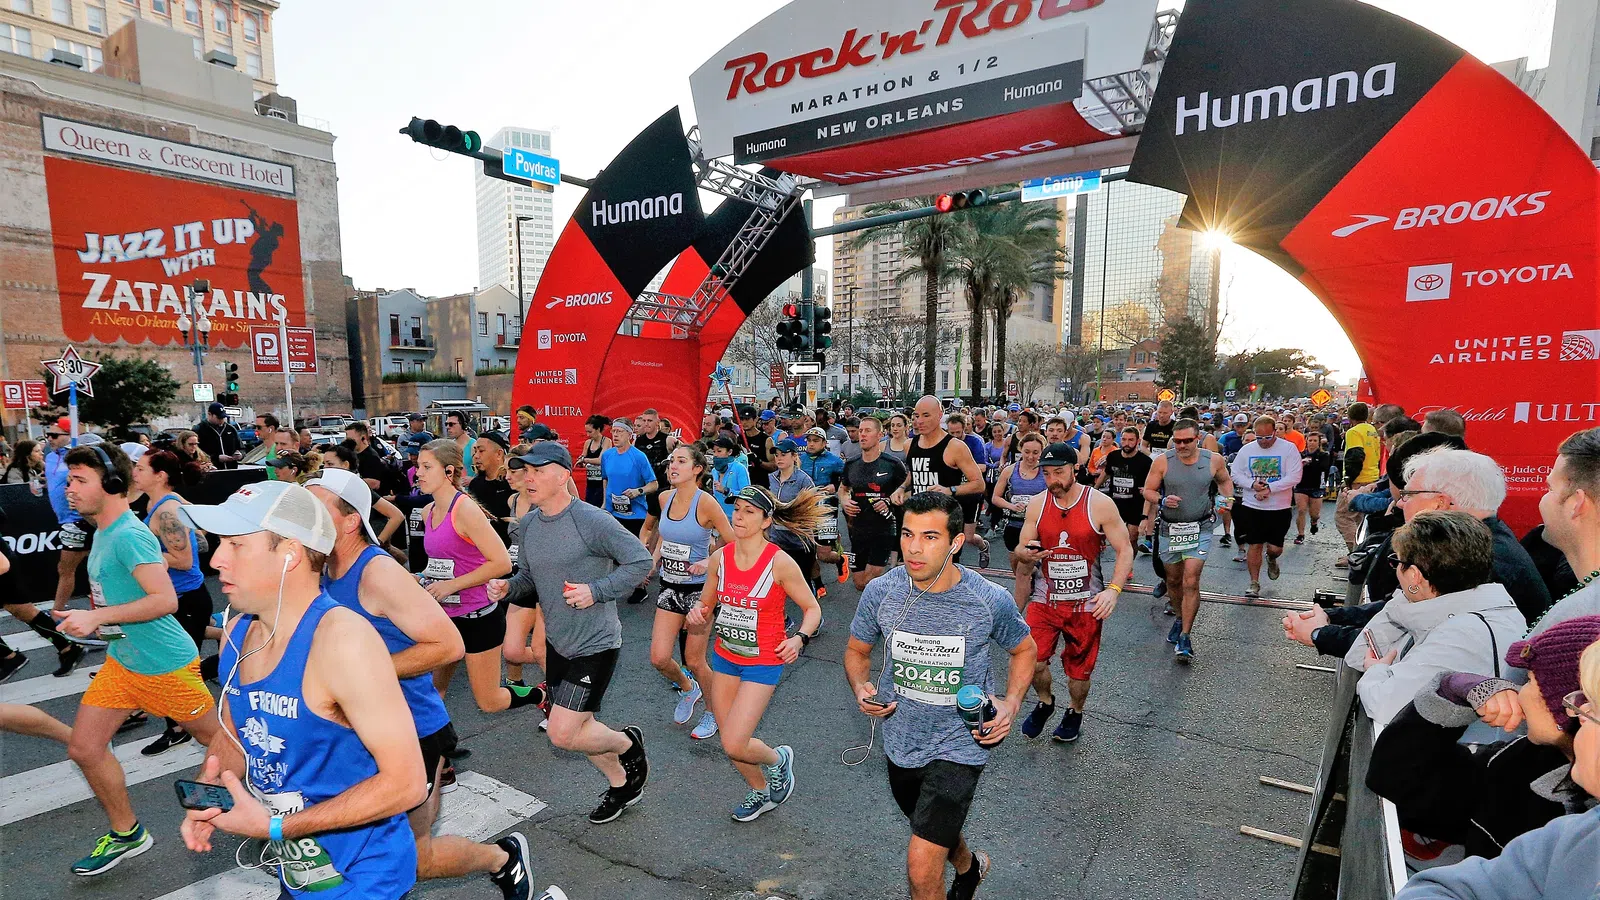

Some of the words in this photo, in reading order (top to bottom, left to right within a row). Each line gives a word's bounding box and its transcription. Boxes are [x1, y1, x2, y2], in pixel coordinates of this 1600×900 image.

[790, 75, 913, 114] MARATHON
[928, 70, 940, 82] &
[1004, 79, 1063, 101] Humana
[1175, 61, 1398, 136] Humana
[817, 120, 857, 139] NEW
[865, 98, 964, 129] ORLEANS
[746, 137, 787, 154] Humana
[59, 126, 131, 157] Queen
[138, 149, 152, 161] &
[160, 146, 235, 177] Crescent
[241, 162, 285, 186] Hotel
[823, 139, 1058, 179] Humana
[515, 152, 556, 178] Poydras
[1043, 175, 1084, 193] Camp
[591, 192, 683, 227] Humana
[1393, 190, 1552, 230] BROOKS
[76, 228, 167, 264] JAZZ
[173, 221, 205, 252] IT
[211, 218, 255, 244] UP
[160, 248, 216, 278] WITH
[1461, 263, 1574, 287] TOYOTA
[565, 291, 613, 307] BROOKS
[90, 312, 101, 324] A
[104, 313, 134, 326] New
[554, 332, 587, 343] TOYOTA
[1455, 334, 1552, 350] UNITED
[1429, 348, 1551, 364] AIRLINES
[57, 359, 83, 374] 3:30
[550, 406, 583, 417] ULTRA
[911, 457, 931, 471] WE
[1512, 465, 1536, 475] Jude
[911, 471, 939, 486] RUN
[1504, 475, 1543, 483] esearch
[1170, 533, 1199, 543] 20668
[1053, 578, 1084, 590] 1308
[717, 594, 758, 608] VOLÉE
[714, 625, 757, 643] 26898
[914, 637, 941, 645] Humana
[918, 658, 953, 666] MARATHON
[894, 663, 961, 685] 20446
[902, 680, 922, 690] TEAM
[248, 690, 299, 719] FRENCH
